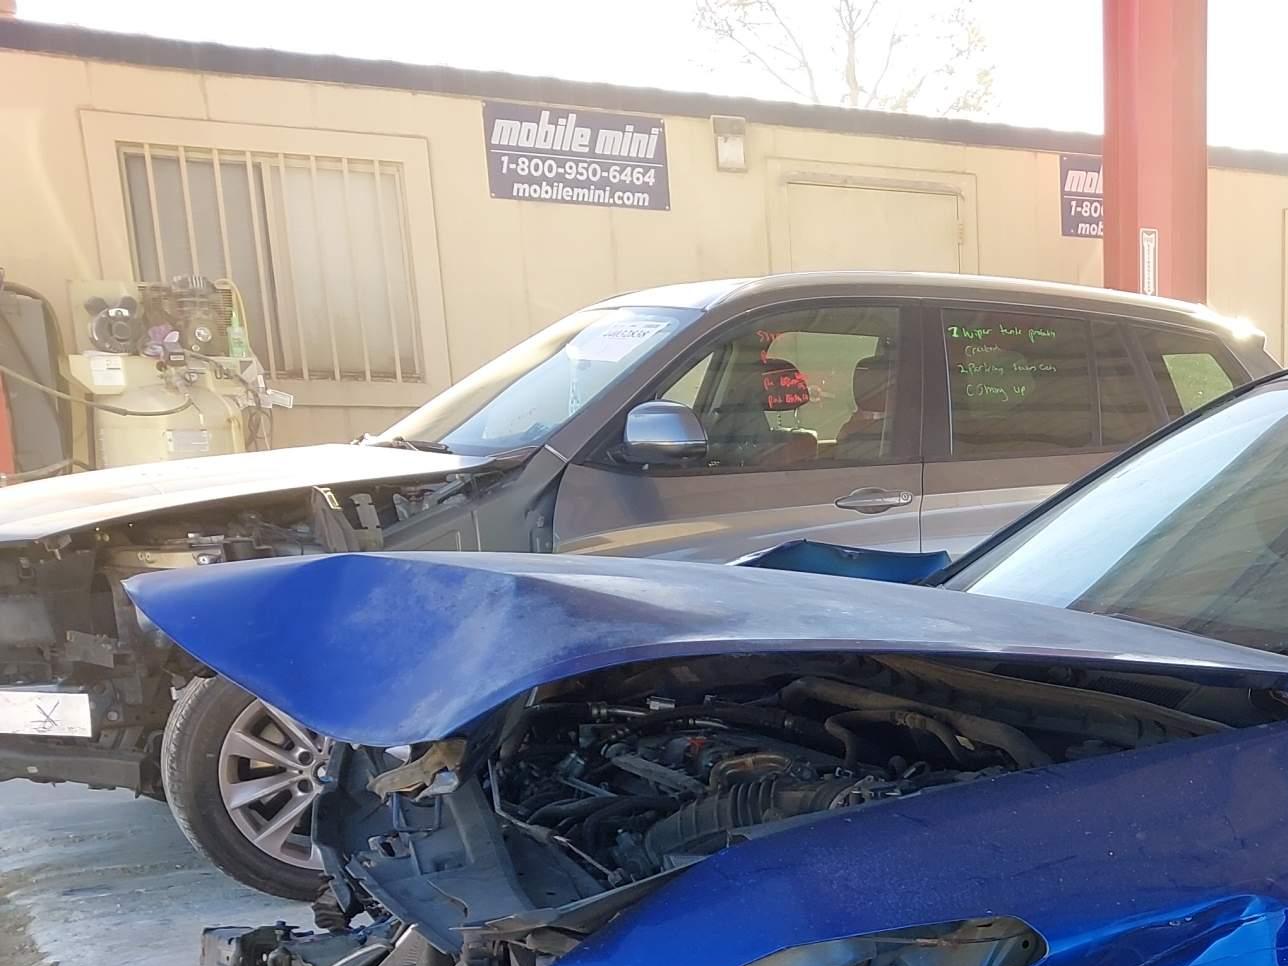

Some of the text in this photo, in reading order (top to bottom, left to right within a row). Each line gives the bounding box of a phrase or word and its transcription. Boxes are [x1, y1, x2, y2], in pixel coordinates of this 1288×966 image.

[491, 110, 660, 158] mobile mini
[500, 155, 656, 186] 1-800-950-6464
[512, 181, 649, 206] mobilemini.com
[1070, 200, 1104, 218] 1-80
